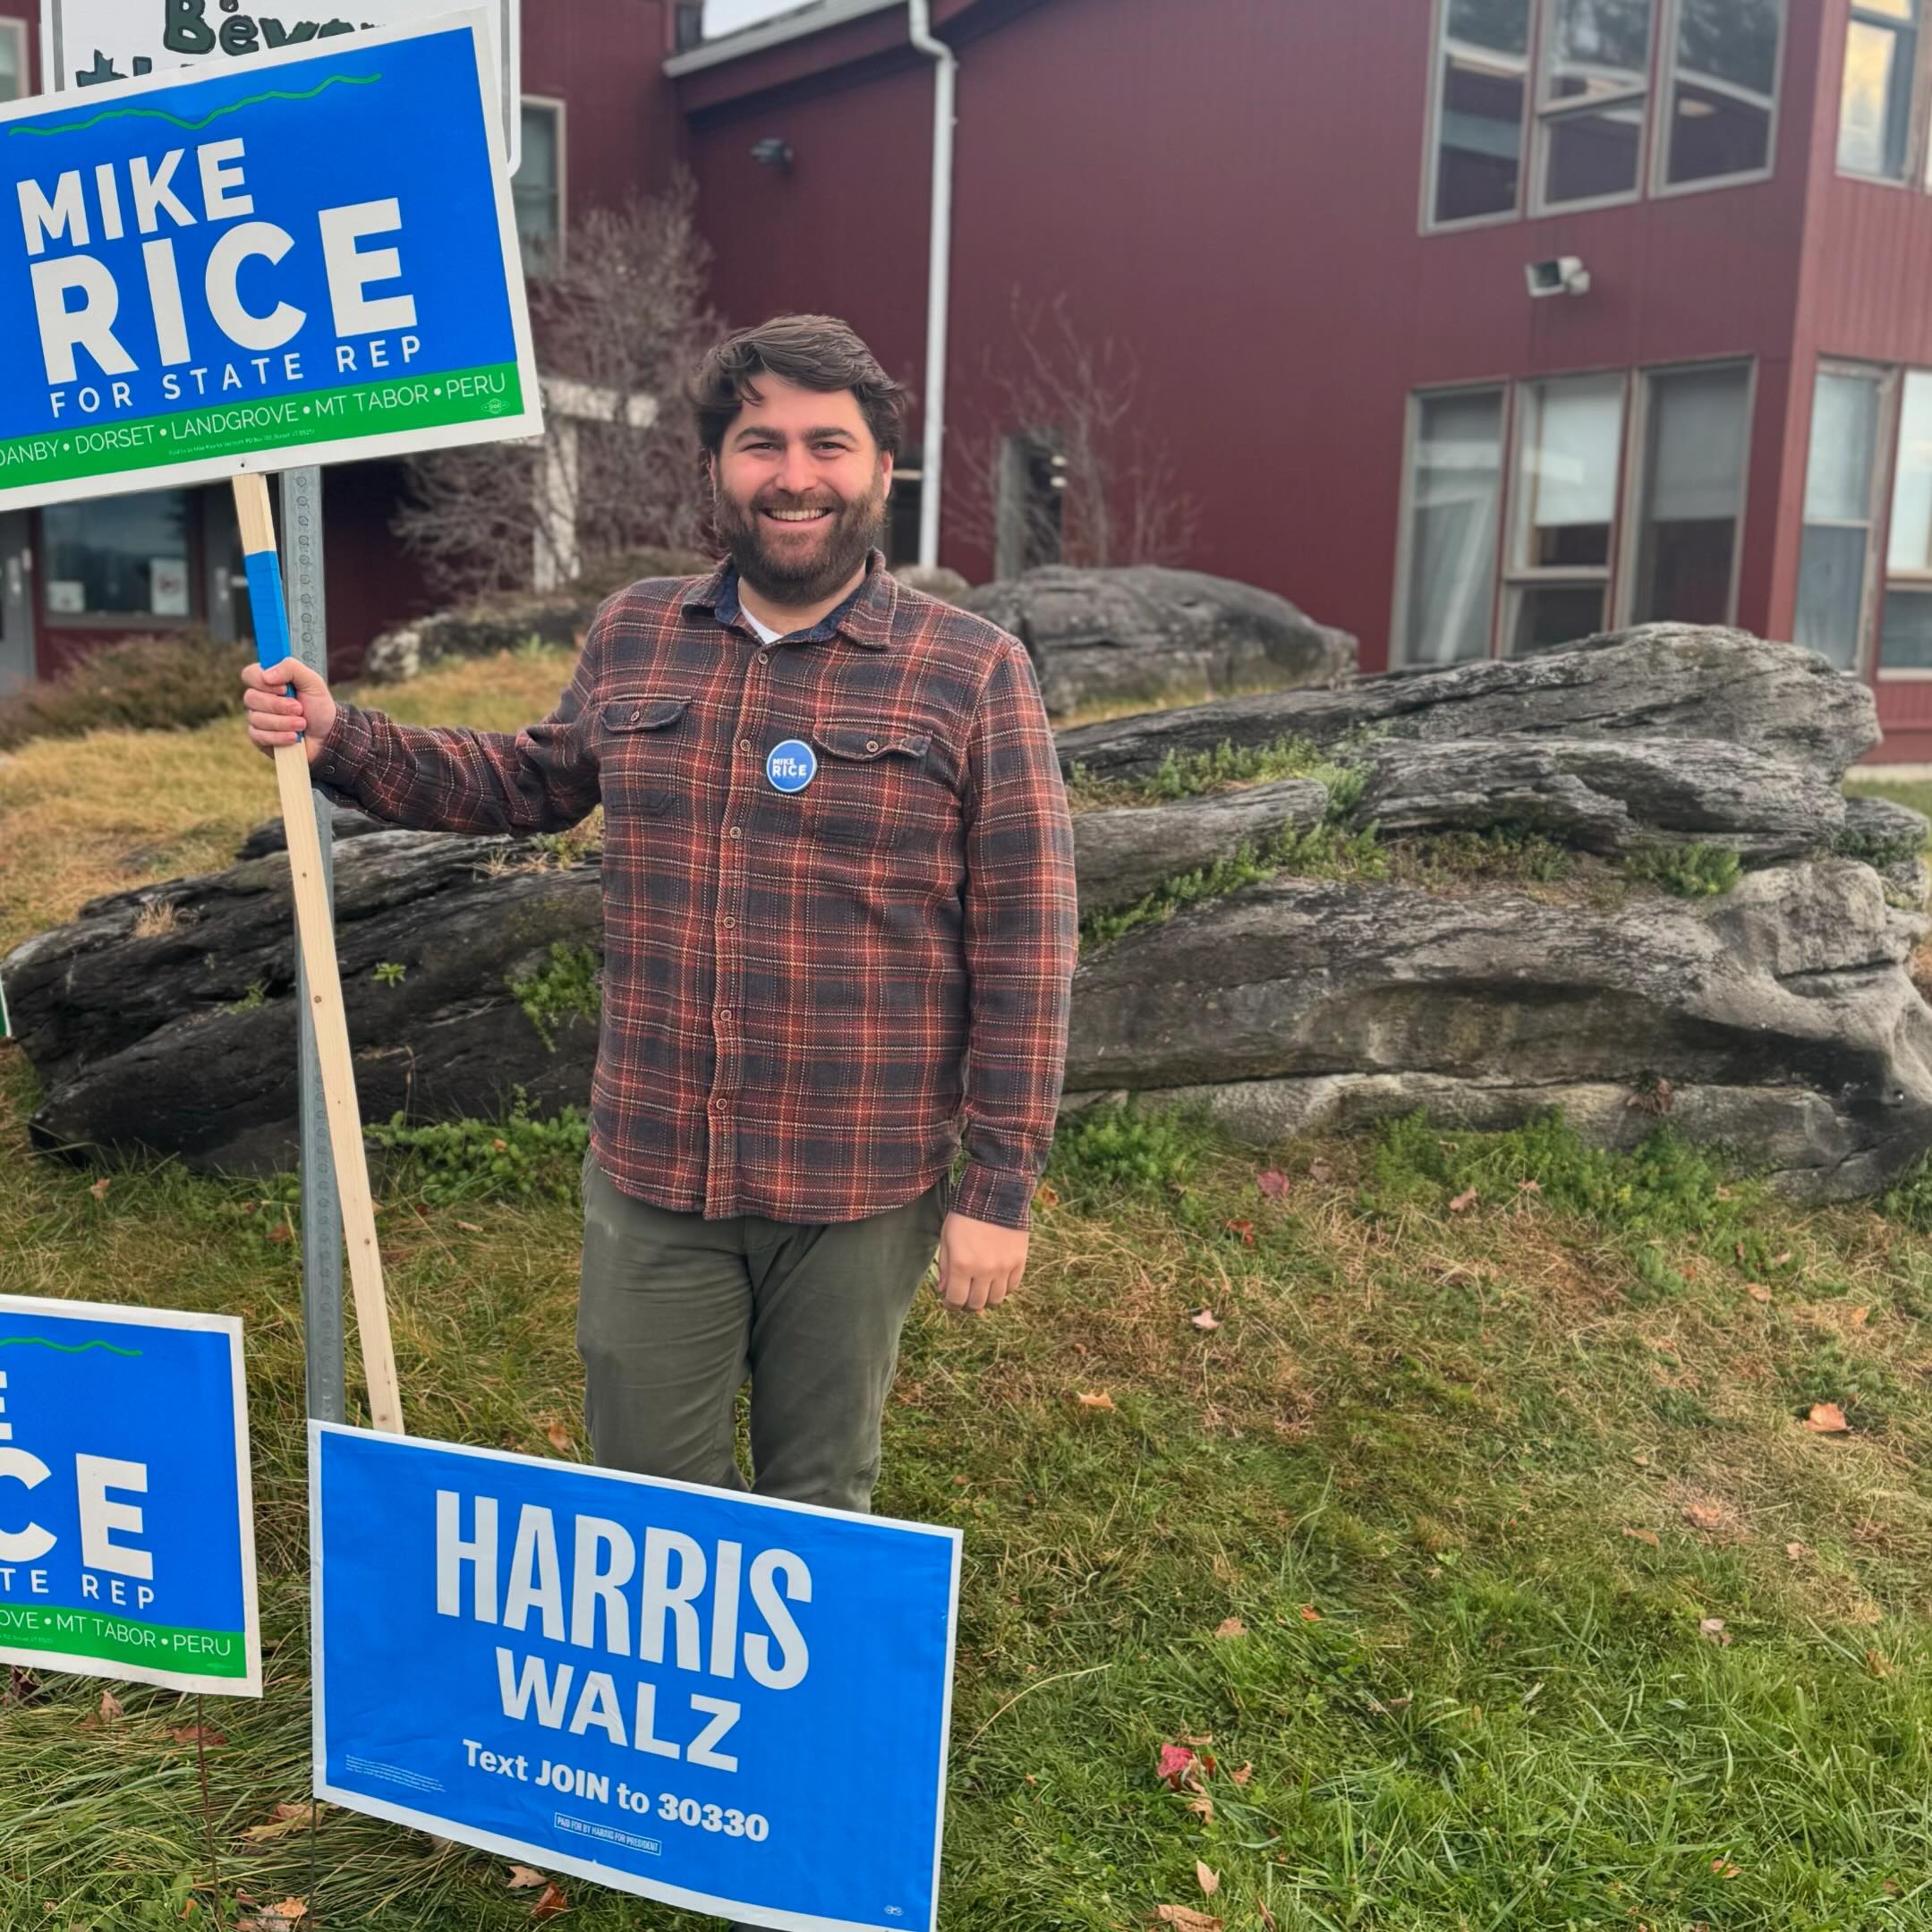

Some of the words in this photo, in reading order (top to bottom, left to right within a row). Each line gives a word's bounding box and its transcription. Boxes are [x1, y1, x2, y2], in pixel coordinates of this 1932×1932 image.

[16, 138, 254, 256] MIKE
[30, 198, 418, 386] RICE
[49, 382, 133, 418] FOR
[162, 353, 304, 399] STATE
[336, 336, 421, 373] REP
[75, 424, 155, 455] DORSET
[171, 403, 300, 440] LANDGROVE
[315, 395, 347, 418] MT
[353, 384, 430, 413] TABOR
[446, 372, 506, 400] PERU
[772, 757, 796, 766] MIKE
[772, 764, 808, 778] RICE
[0, 1446, 154, 1581] CE
[81, 1573, 155, 1610] REP
[435, 1489, 813, 1690] HARRIS
[56, 1613, 87, 1633] MT
[91, 1618, 157, 1648] TABOR
[174, 1634, 231, 1656] PERU
[495, 1647, 742, 1774] WALZ
[463, 1739, 529, 1782] Text
[535, 1760, 609, 1805] JOIN
[617, 1783, 651, 1815] to
[658, 1792, 770, 1843] 30330
[557, 1817, 571, 1828] PAID
[571, 1820, 583, 1832] FOR
[583, 1824, 592, 1834] BY
[614, 1832, 626, 1843] FOR
